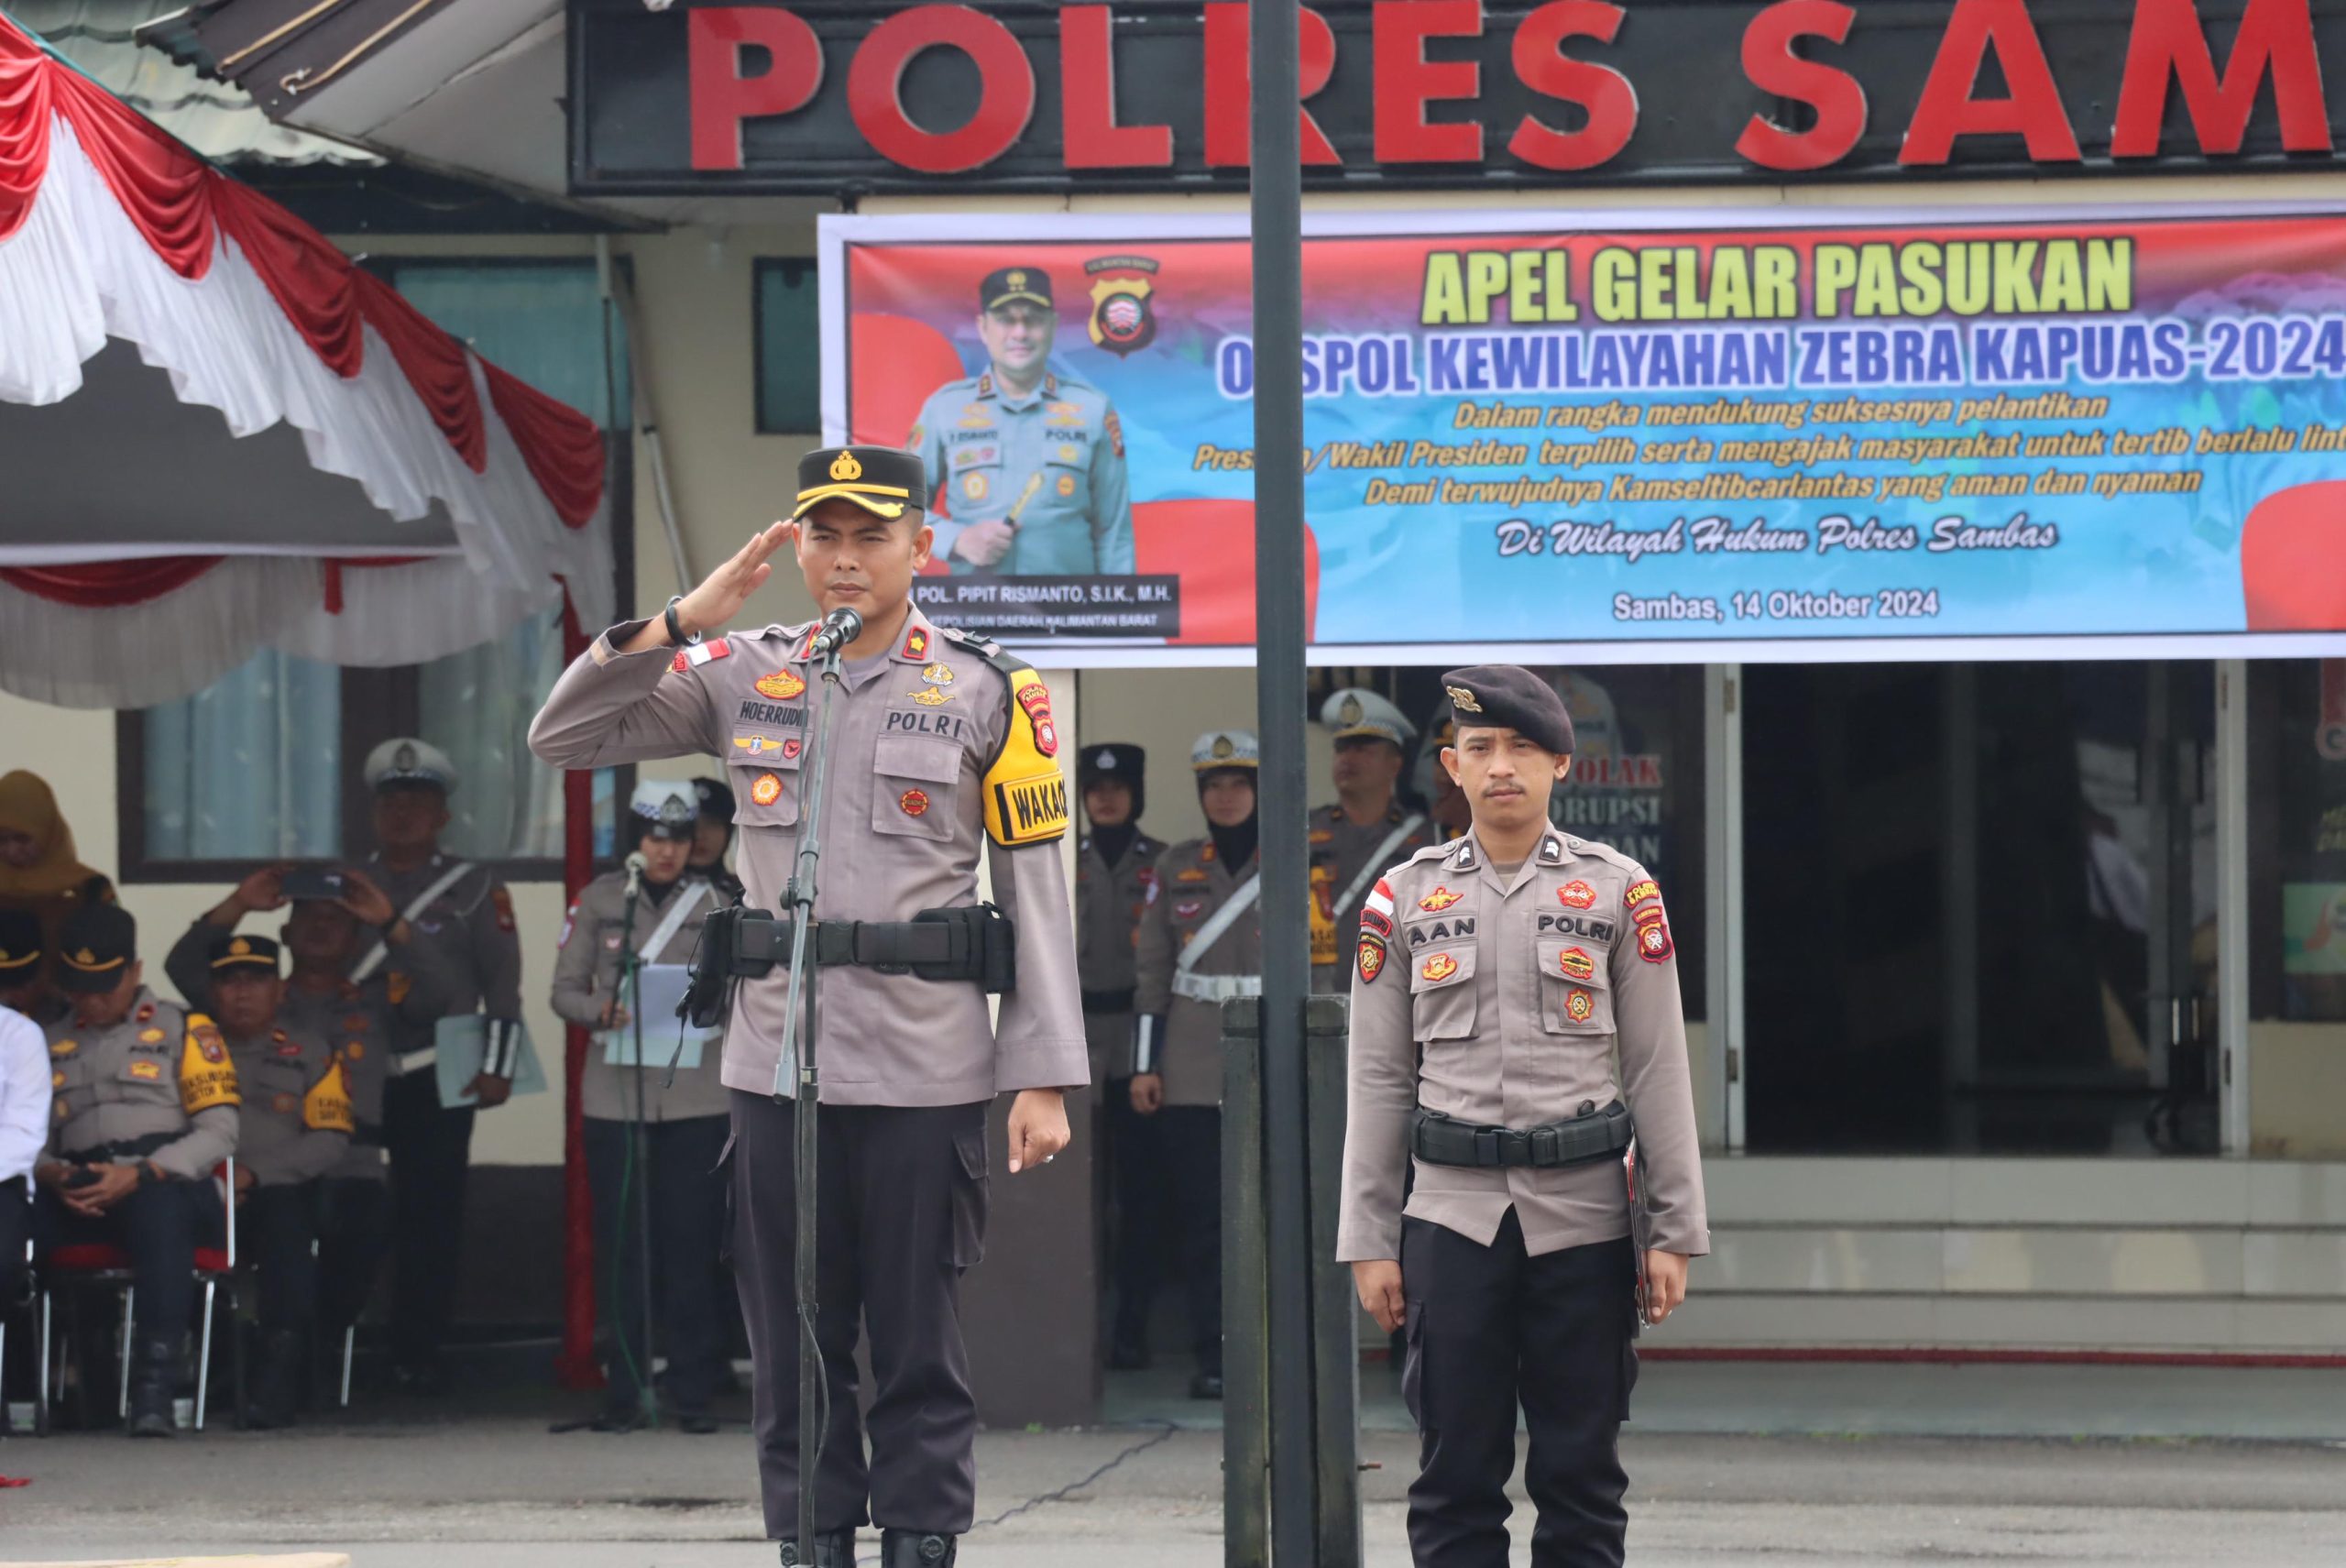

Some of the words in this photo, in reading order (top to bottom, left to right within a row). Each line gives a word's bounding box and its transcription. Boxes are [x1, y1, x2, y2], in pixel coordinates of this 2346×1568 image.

[687, 0, 1640, 174] POLRES
[1735, 0, 2334, 171] SAM
[1420, 249, 1579, 325] APEL
[1592, 246, 1799, 323] GELAR
[1814, 236, 2133, 318] PASUKAN
[1220, 336, 1418, 397] OSPOL
[1429, 331, 1786, 392] KEWILAYAHAN
[1799, 327, 1961, 386] ZEBRA
[1974, 318, 2346, 381] KAPUAS-2024
[1453, 400, 1541, 429] Dalam
[1545, 399, 1642, 432] rangka
[1646, 398, 1810, 430] mendukung
[1810, 396, 1954, 428] suksesnya
[1955, 392, 2110, 428] pelantikan
[1409, 439, 1529, 467] Presiden
[1538, 436, 1638, 470] terpilih
[1641, 437, 1713, 464] serta
[1718, 433, 1855, 467] mengajak
[1858, 430, 2023, 466] masyarakat
[2023, 428, 2108, 457] untuk
[2111, 426, 2191, 455] tertib
[2195, 424, 2297, 455] berlalu
[1365, 477, 1439, 505] Demi
[1441, 475, 1604, 507] terwujudnya
[1608, 471, 1875, 503] Kamseltibcarlantas
[1875, 473, 1950, 503] yang
[1950, 473, 2030, 497] aman
[2033, 466, 2089, 496] dan
[2091, 470, 2203, 499] nyaman
[1496, 519, 1544, 556] Di
[1550, 516, 1686, 564] Wilayah
[1690, 516, 1809, 554] Hukum
[1817, 515, 1920, 555] Polres
[1927, 511, 2060, 553] Sambas
[916, 585, 954, 604] POL.
[957, 585, 997, 603] PIPIT
[1000, 585, 1088, 605] RISMANTO,
[1137, 585, 1173, 602] M.H.
[1612, 591, 1725, 624] Sambas,
[1731, 591, 1761, 619] 14
[1767, 589, 1872, 620] Oktober
[1877, 588, 1940, 618] 2024
[996, 613, 1046, 628] DAERAH
[1118, 613, 1158, 627] BARAT
[886, 711, 963, 739] POLRI
[1557, 757, 1662, 785] OLAK
[1596, 834, 1661, 864] AN
[1409, 917, 1475, 947] AAN
[1537, 915, 1615, 942] POLRI
